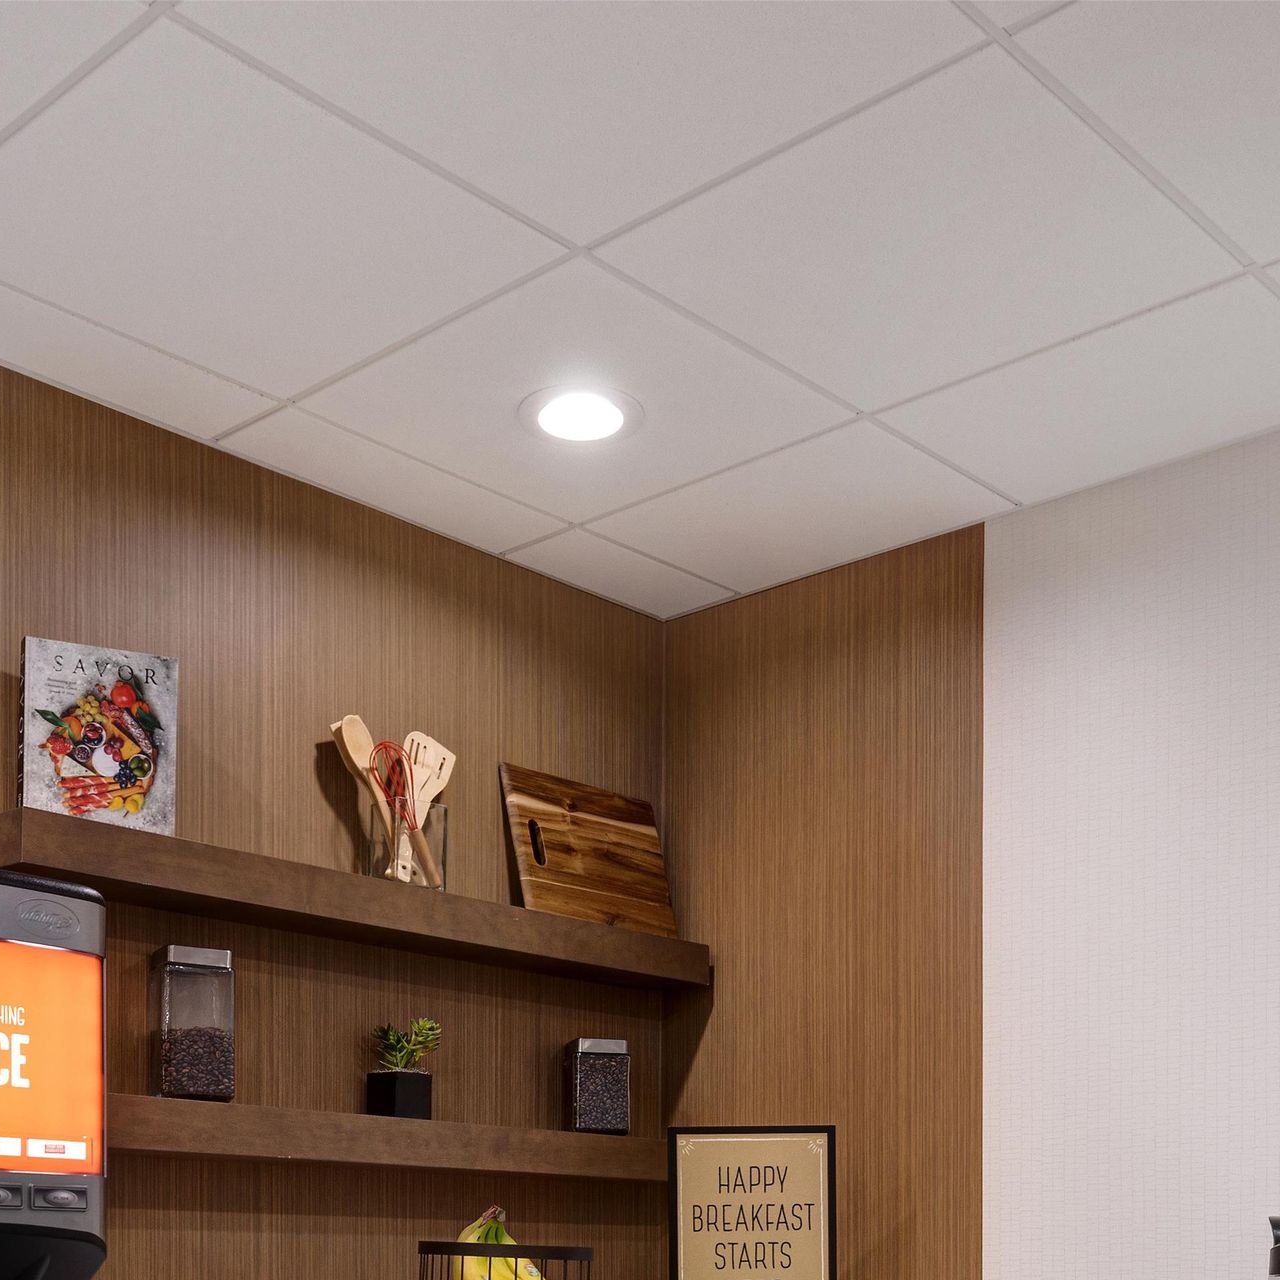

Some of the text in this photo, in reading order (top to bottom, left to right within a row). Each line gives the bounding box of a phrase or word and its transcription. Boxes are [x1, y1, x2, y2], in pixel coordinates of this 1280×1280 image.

[53, 655, 158, 685] SAVOR
[718, 1165, 788, 1194] HAPPY
[692, 1203, 815, 1232] BREAKFAST
[714, 1241, 792, 1270] STARTS
